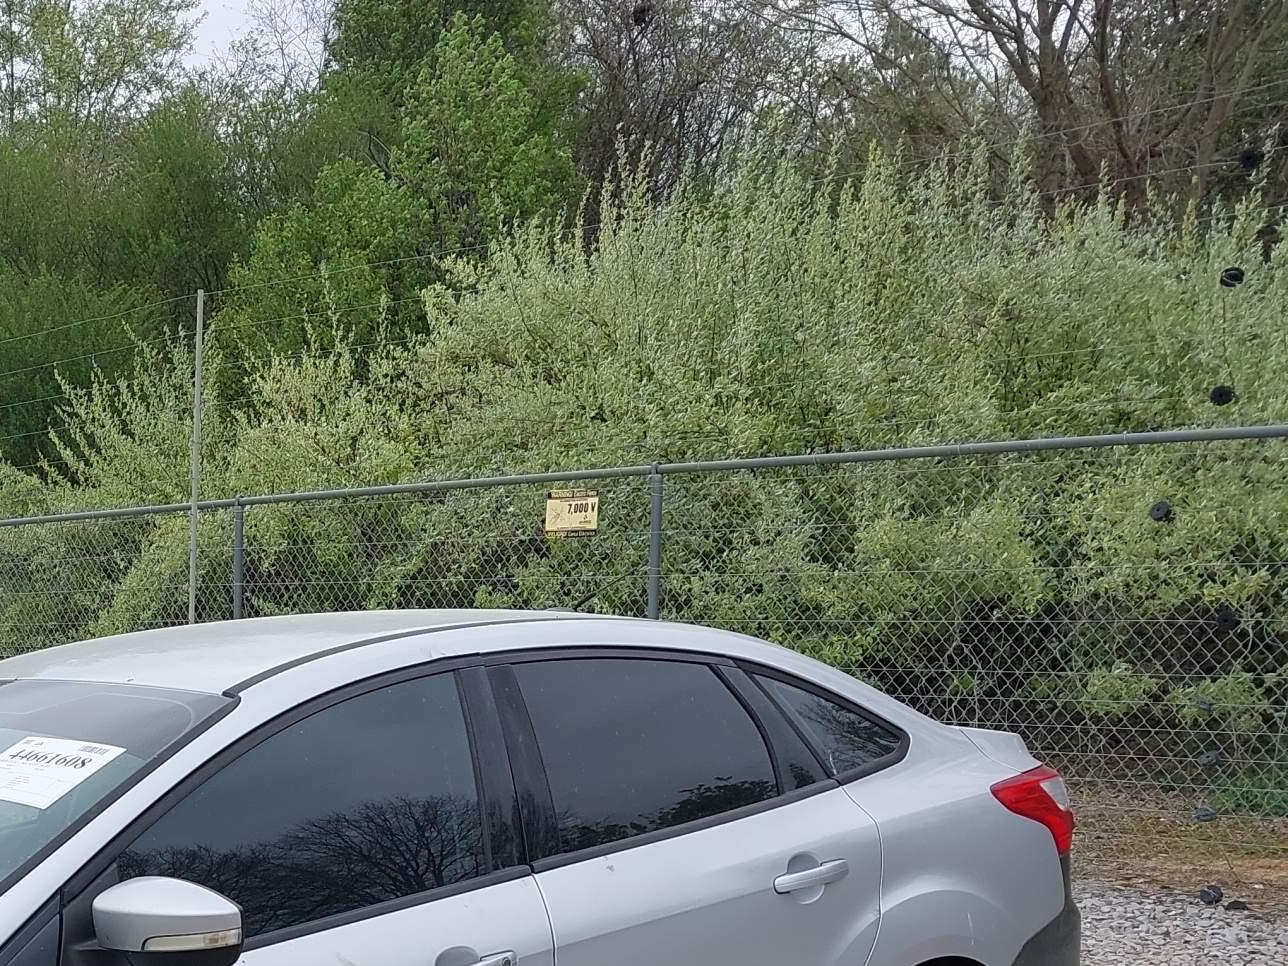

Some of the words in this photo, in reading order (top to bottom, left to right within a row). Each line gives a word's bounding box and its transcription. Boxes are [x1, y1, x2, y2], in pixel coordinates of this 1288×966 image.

[567, 502, 589, 515] 7,000
[591, 501, 596, 513] V
[9, 748, 93, 769] 44661608
